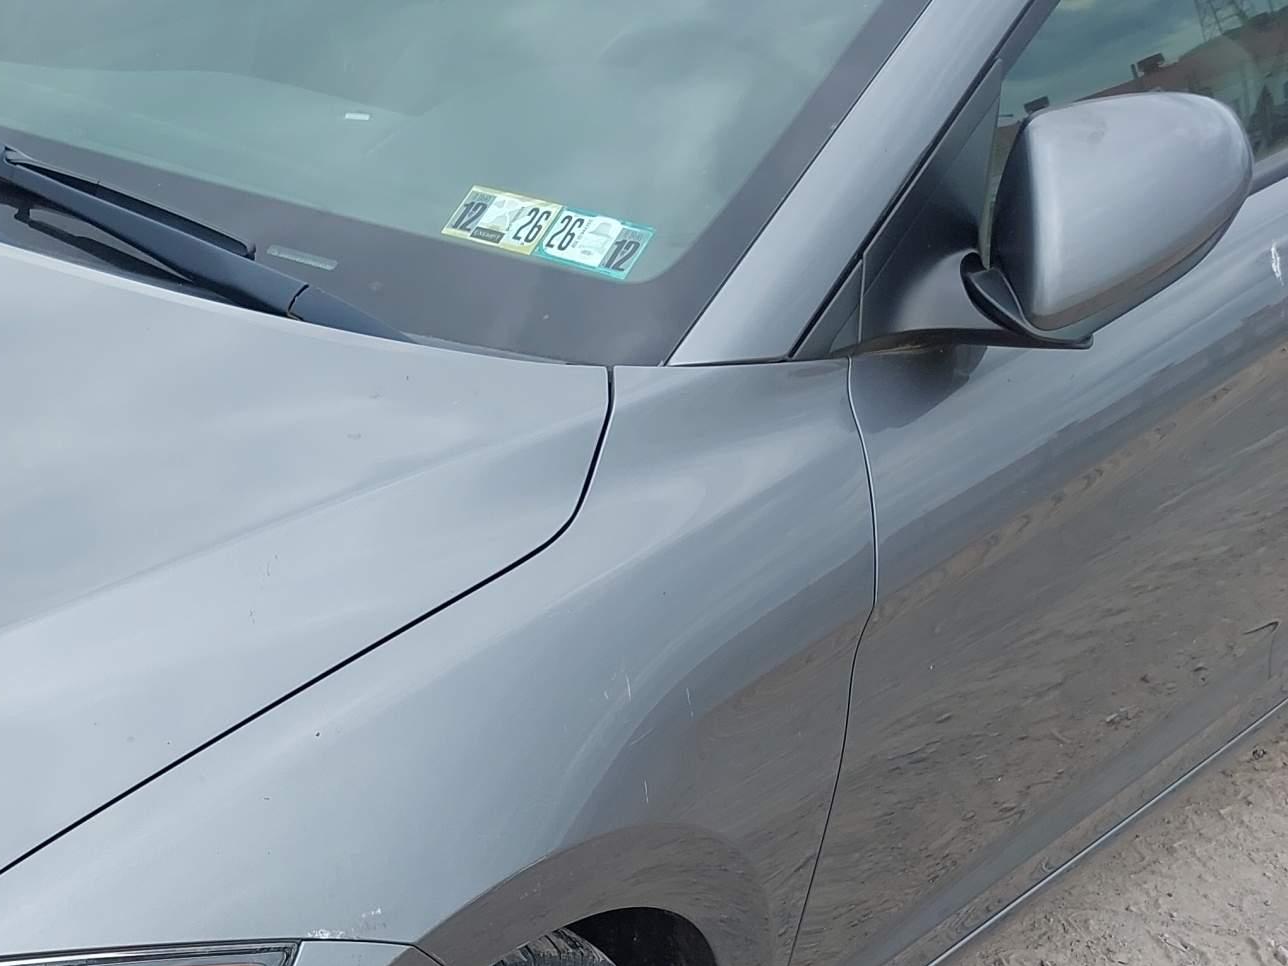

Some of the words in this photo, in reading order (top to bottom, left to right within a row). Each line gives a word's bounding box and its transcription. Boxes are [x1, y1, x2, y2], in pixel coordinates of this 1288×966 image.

[452, 201, 488, 231] 12
[512, 207, 551, 243] 26
[545, 215, 585, 251] 26
[604, 239, 640, 271] 12
